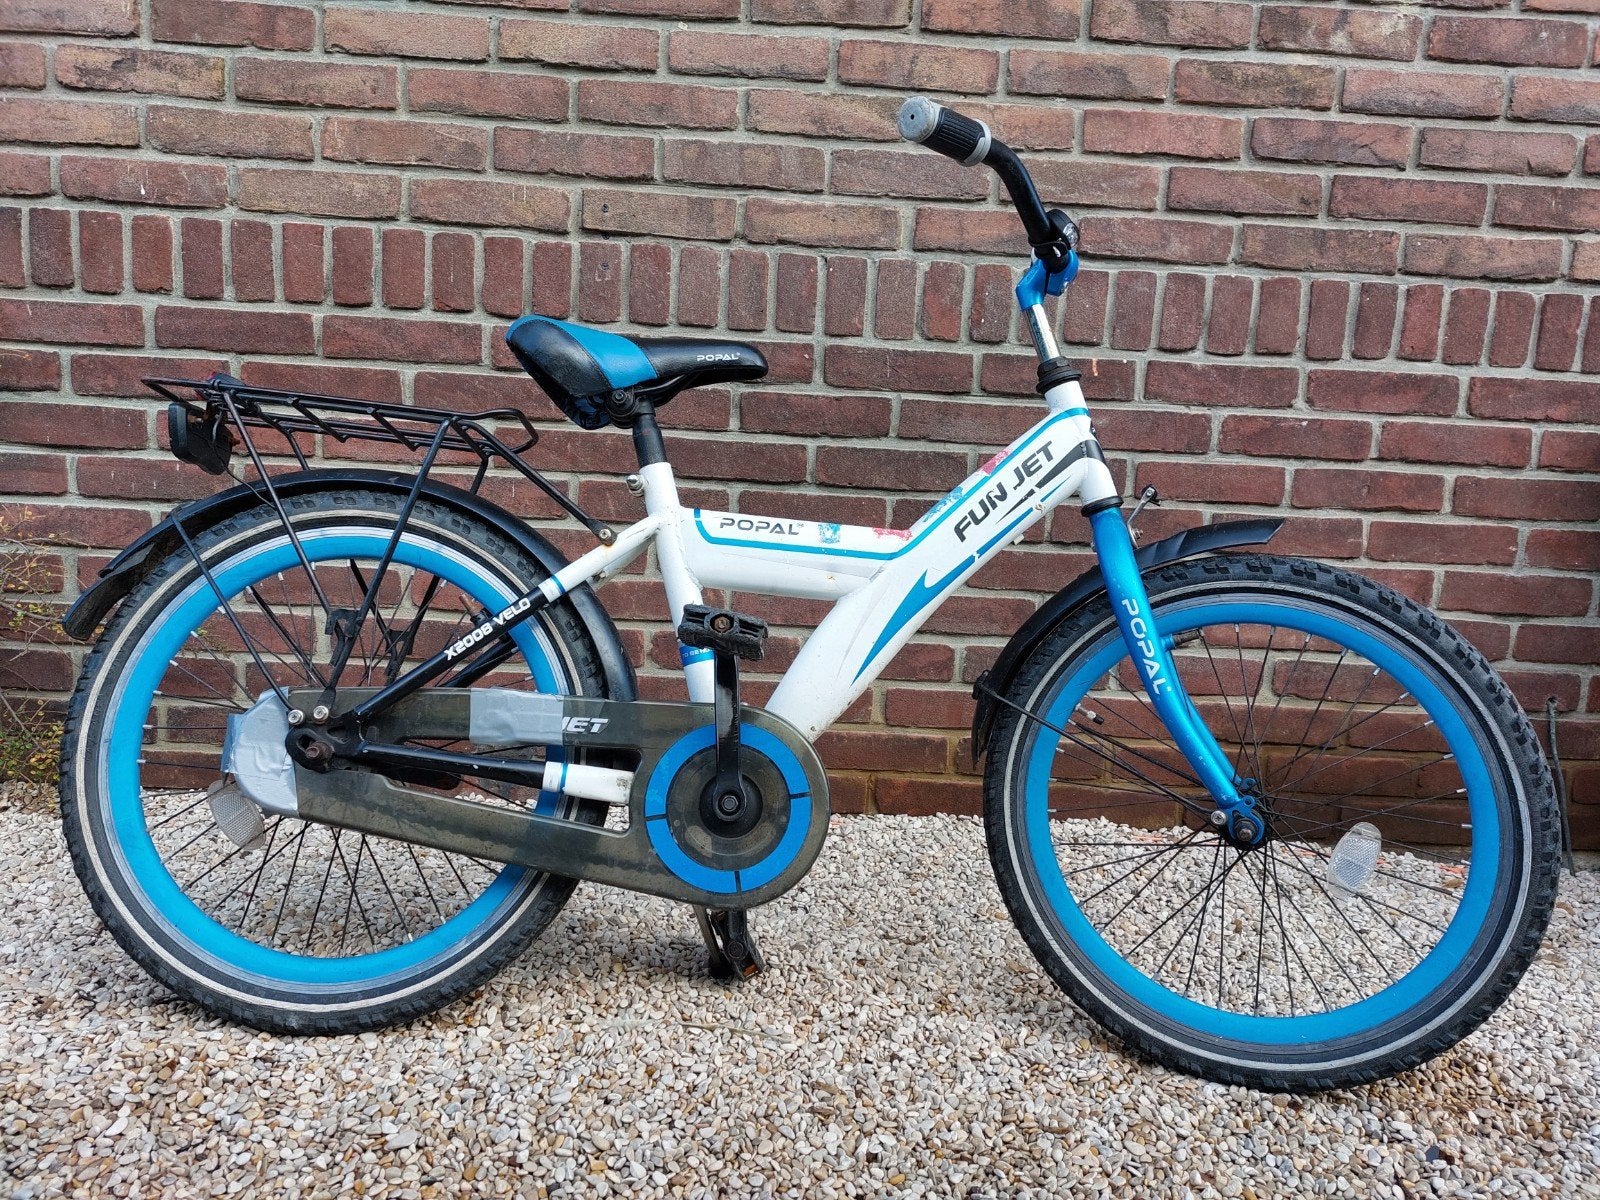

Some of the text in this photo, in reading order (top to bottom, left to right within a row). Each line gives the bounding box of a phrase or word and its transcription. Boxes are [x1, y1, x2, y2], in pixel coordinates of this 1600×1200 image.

[696, 353, 739, 361] POPAL
[953, 440, 1053, 543] FUN JET
[719, 517, 800, 536] POPAL
[443, 597, 531, 661] X2008 VELO
[1121, 598, 1169, 695] POPAL
